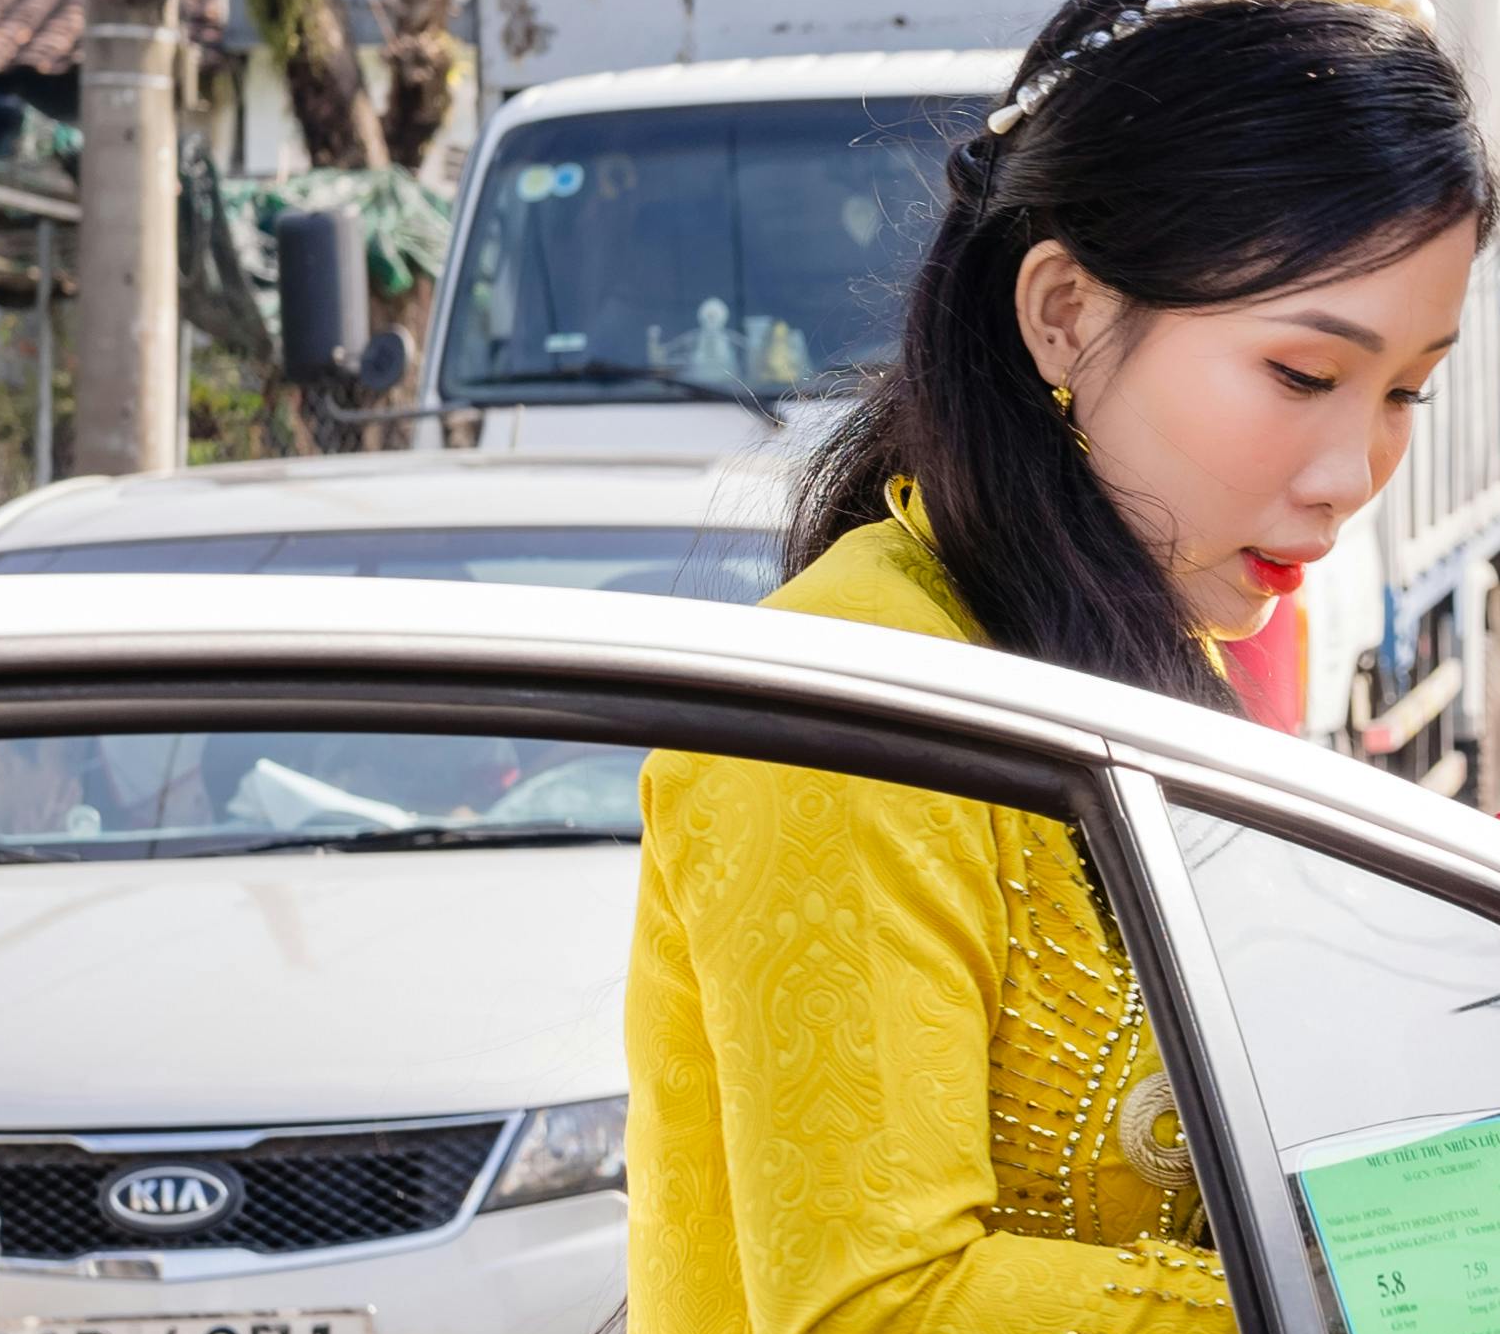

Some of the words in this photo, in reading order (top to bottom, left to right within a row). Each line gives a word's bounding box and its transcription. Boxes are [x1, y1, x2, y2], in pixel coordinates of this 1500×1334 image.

[129, 1178, 206, 1214] KIA
[1463, 1261, 1488, 1279] 7,59
[1377, 1272, 1405, 1297] 5,8
